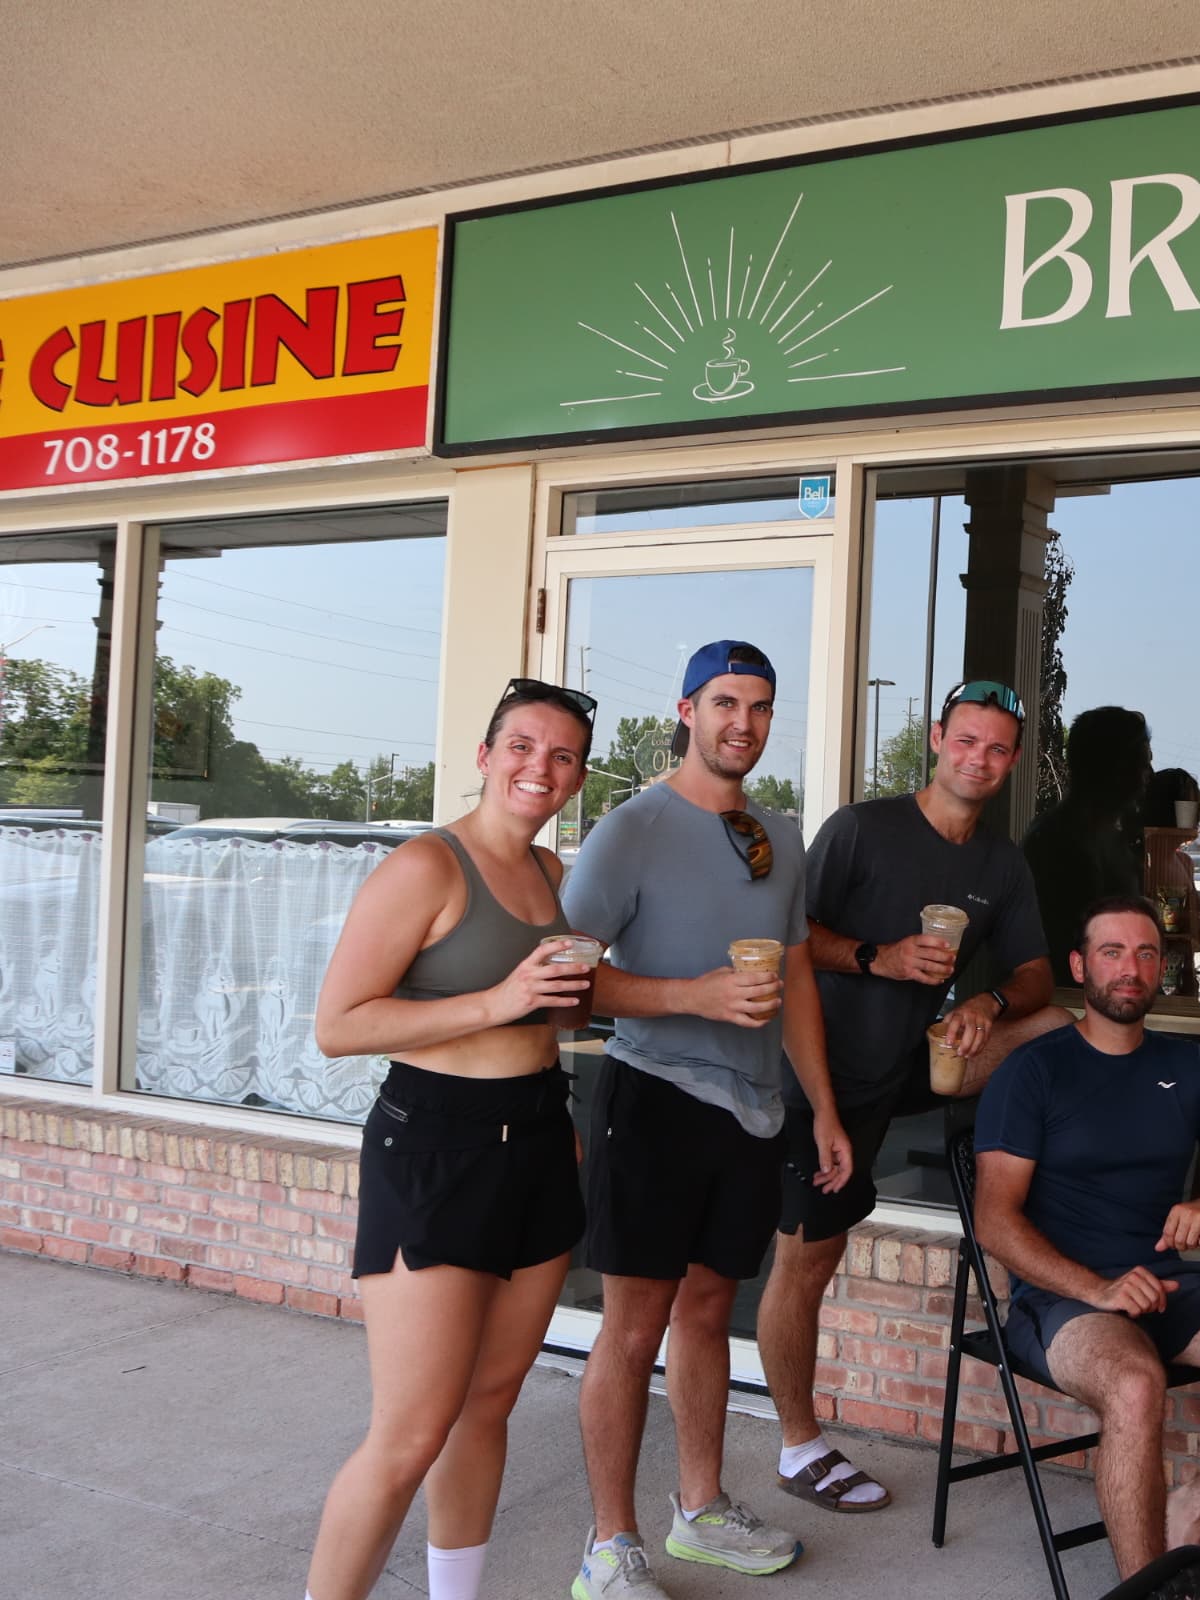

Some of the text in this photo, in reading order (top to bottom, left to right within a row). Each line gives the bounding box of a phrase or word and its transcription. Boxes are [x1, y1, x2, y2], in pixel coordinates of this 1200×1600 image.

[29, 275, 407, 412] CUISINE
[43, 422, 217, 476] 708-1178
[804, 486, 824, 500] Bell
